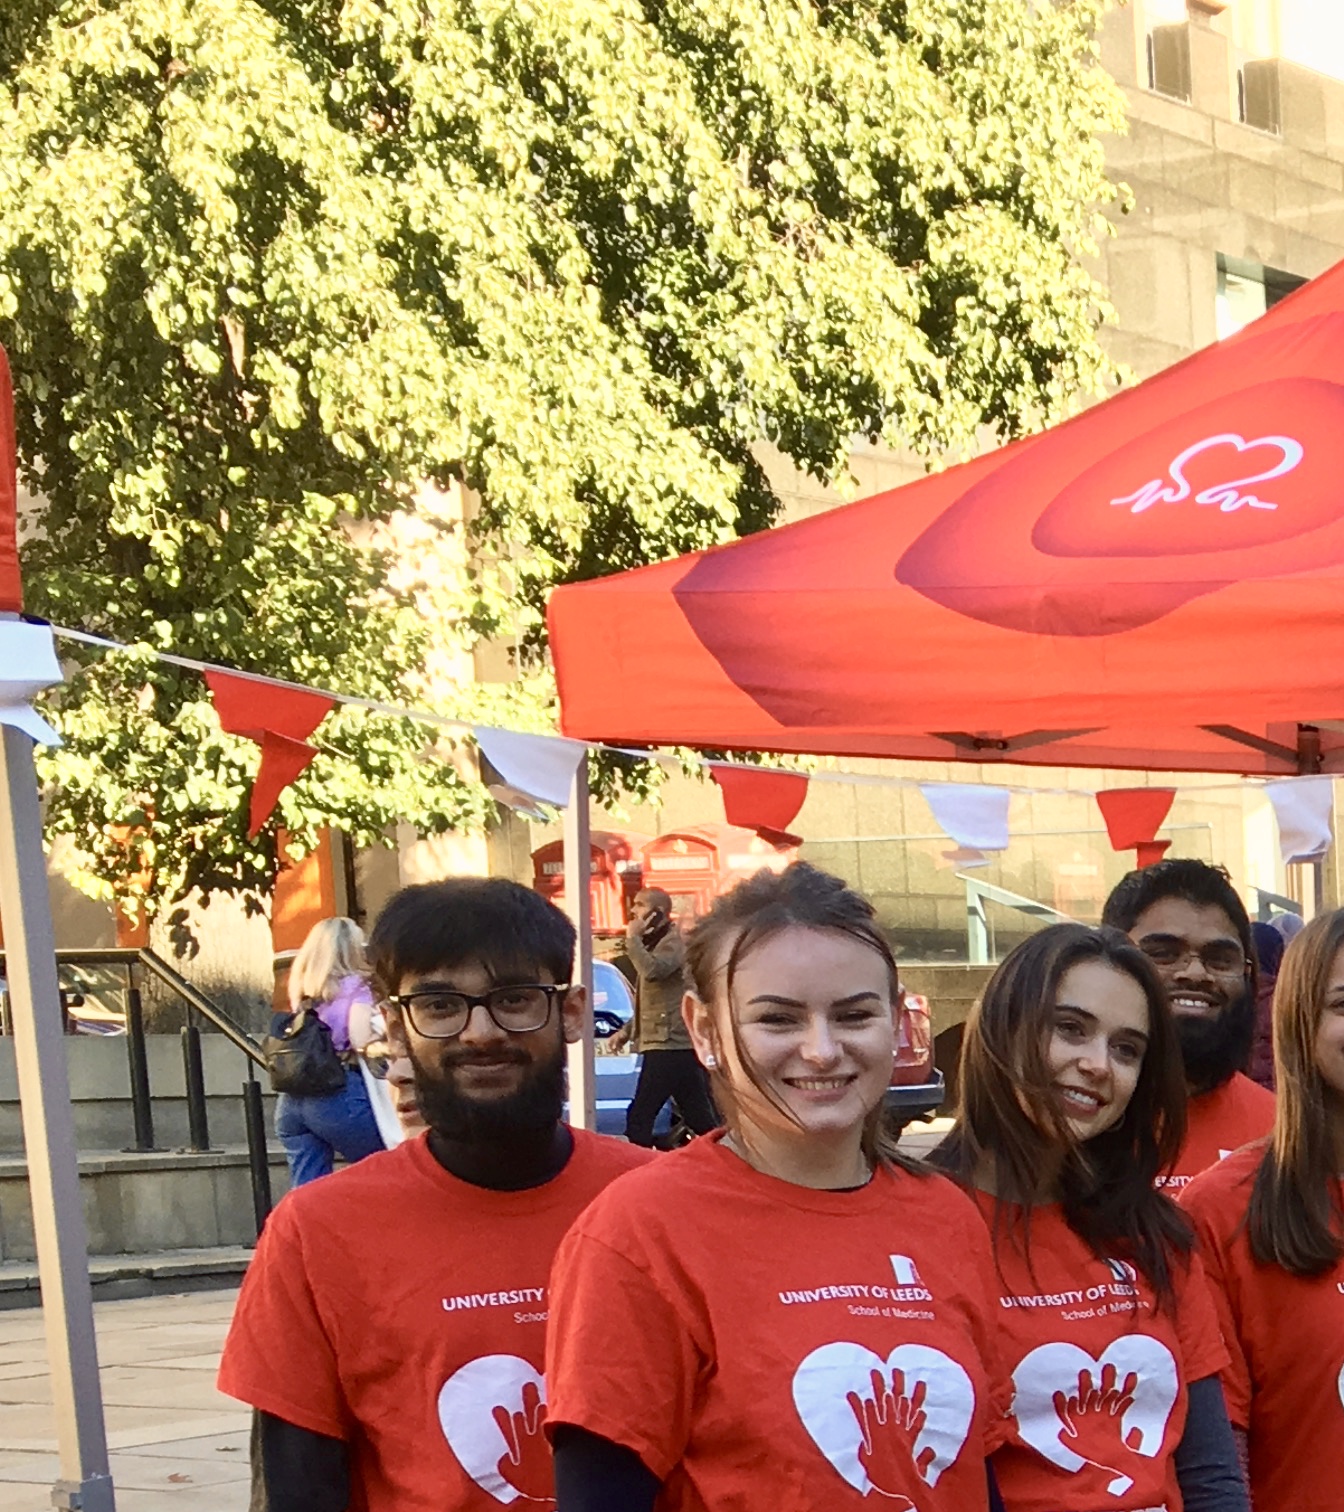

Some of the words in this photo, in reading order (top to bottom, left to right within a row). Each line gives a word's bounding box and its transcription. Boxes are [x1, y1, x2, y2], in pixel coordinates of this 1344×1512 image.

[442, 1287, 544, 1311] UNIVERSITY
[779, 1285, 869, 1305] UNIVERSITY
[871, 1286, 888, 1299] OF
[890, 1287, 934, 1302] LEEDS
[1086, 1284, 1107, 1301] OF
[847, 1304, 880, 1317] School
[881, 1306, 892, 1318] of
[892, 1306, 935, 1321] Medicine
[1061, 1306, 1095, 1321] School
[1096, 1304, 1108, 1318] of
